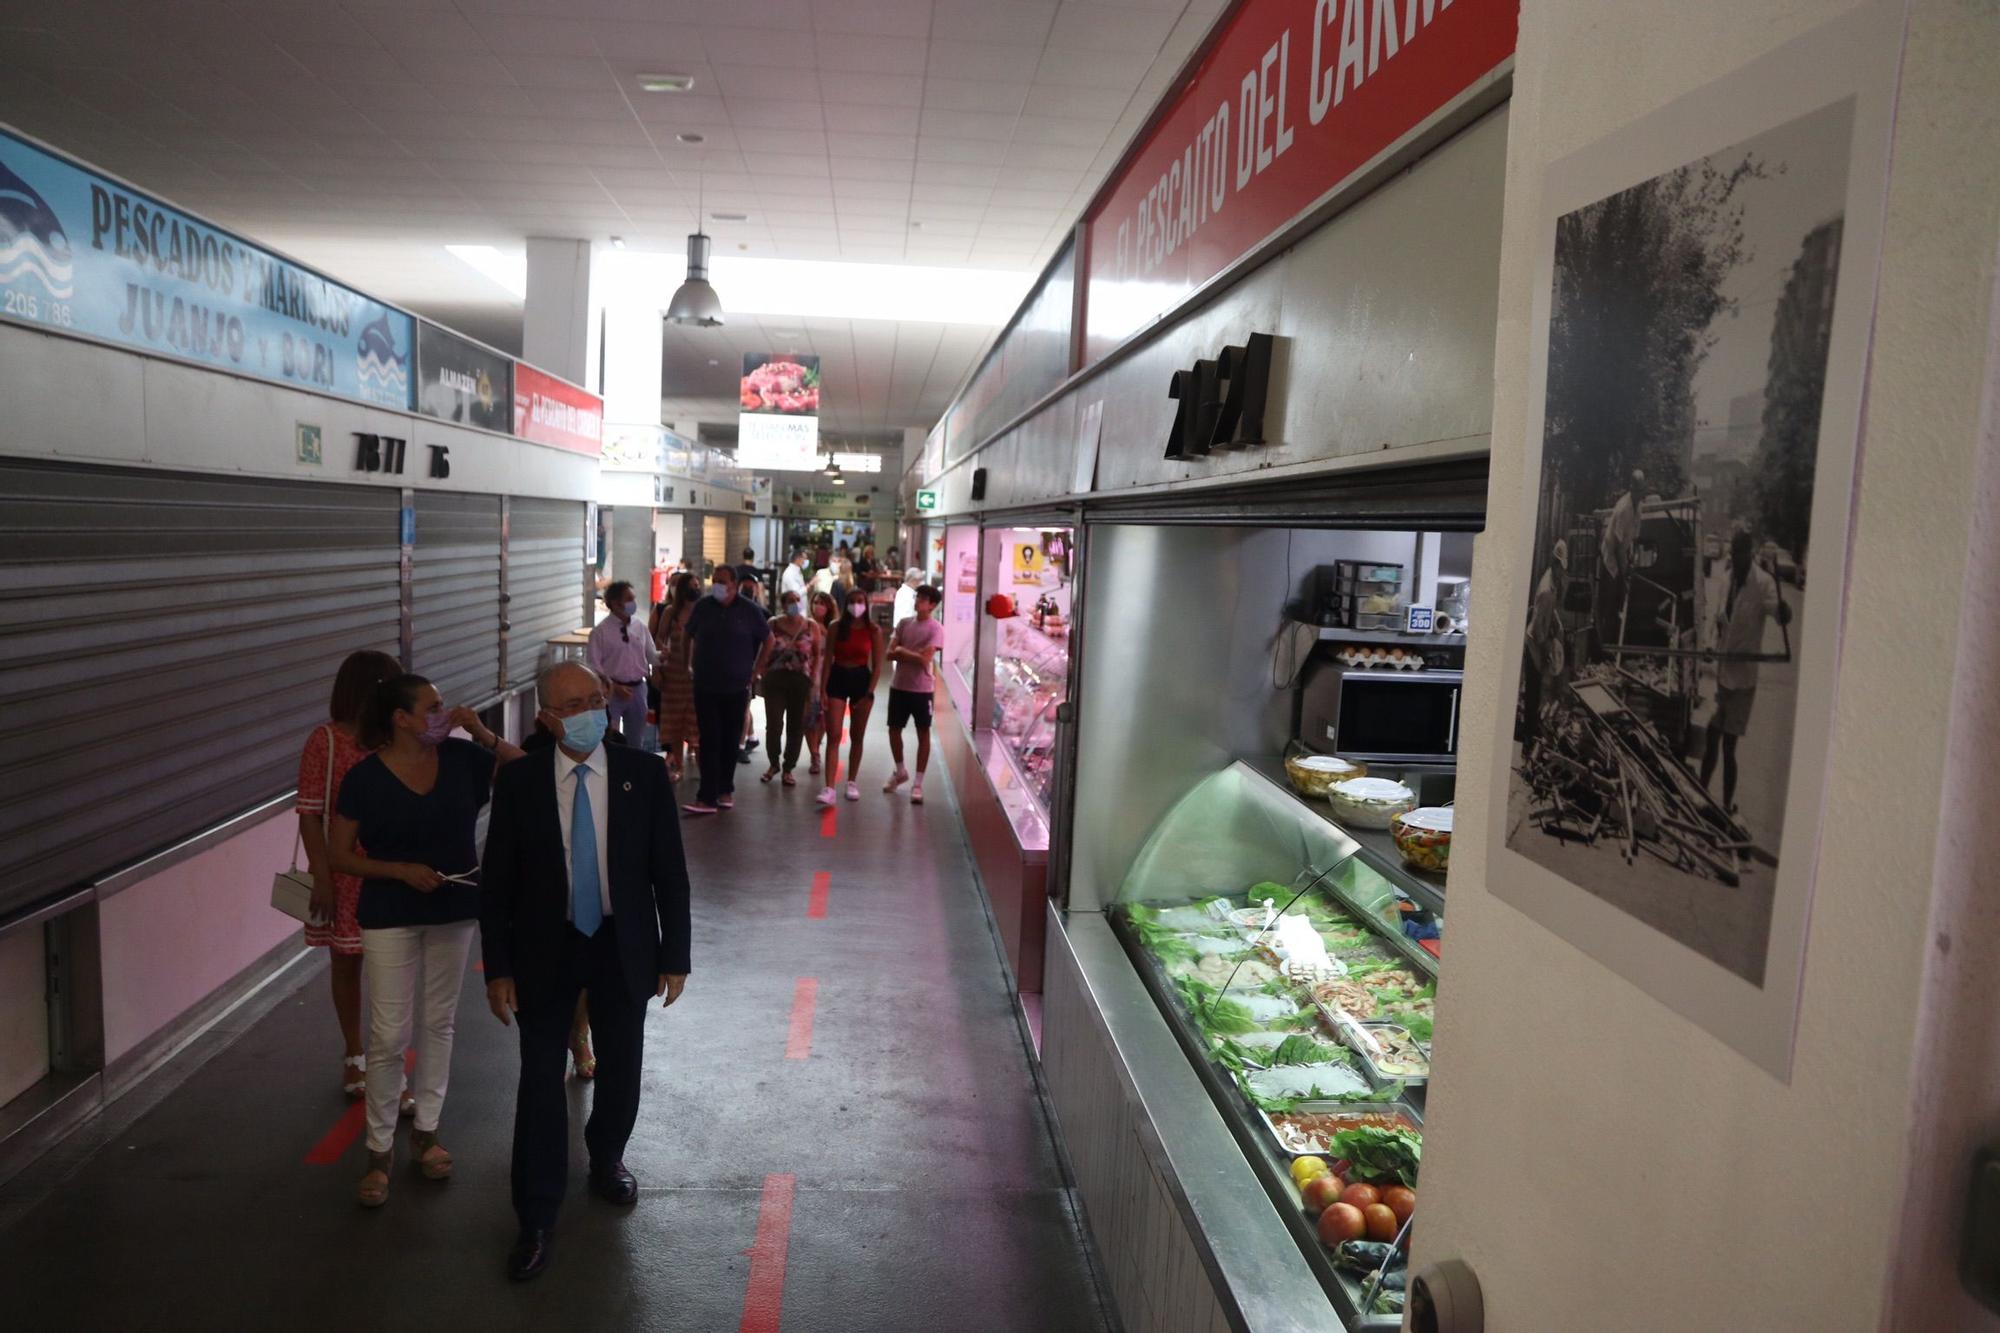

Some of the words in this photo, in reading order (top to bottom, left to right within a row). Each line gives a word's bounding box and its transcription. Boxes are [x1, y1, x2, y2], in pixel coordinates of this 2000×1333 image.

[1136, 101, 1230, 280] PESCAITO
[1236, 28, 1294, 192] DEL
[90, 183, 234, 295] PESCADOS
[119, 282, 246, 363] JUANJO
